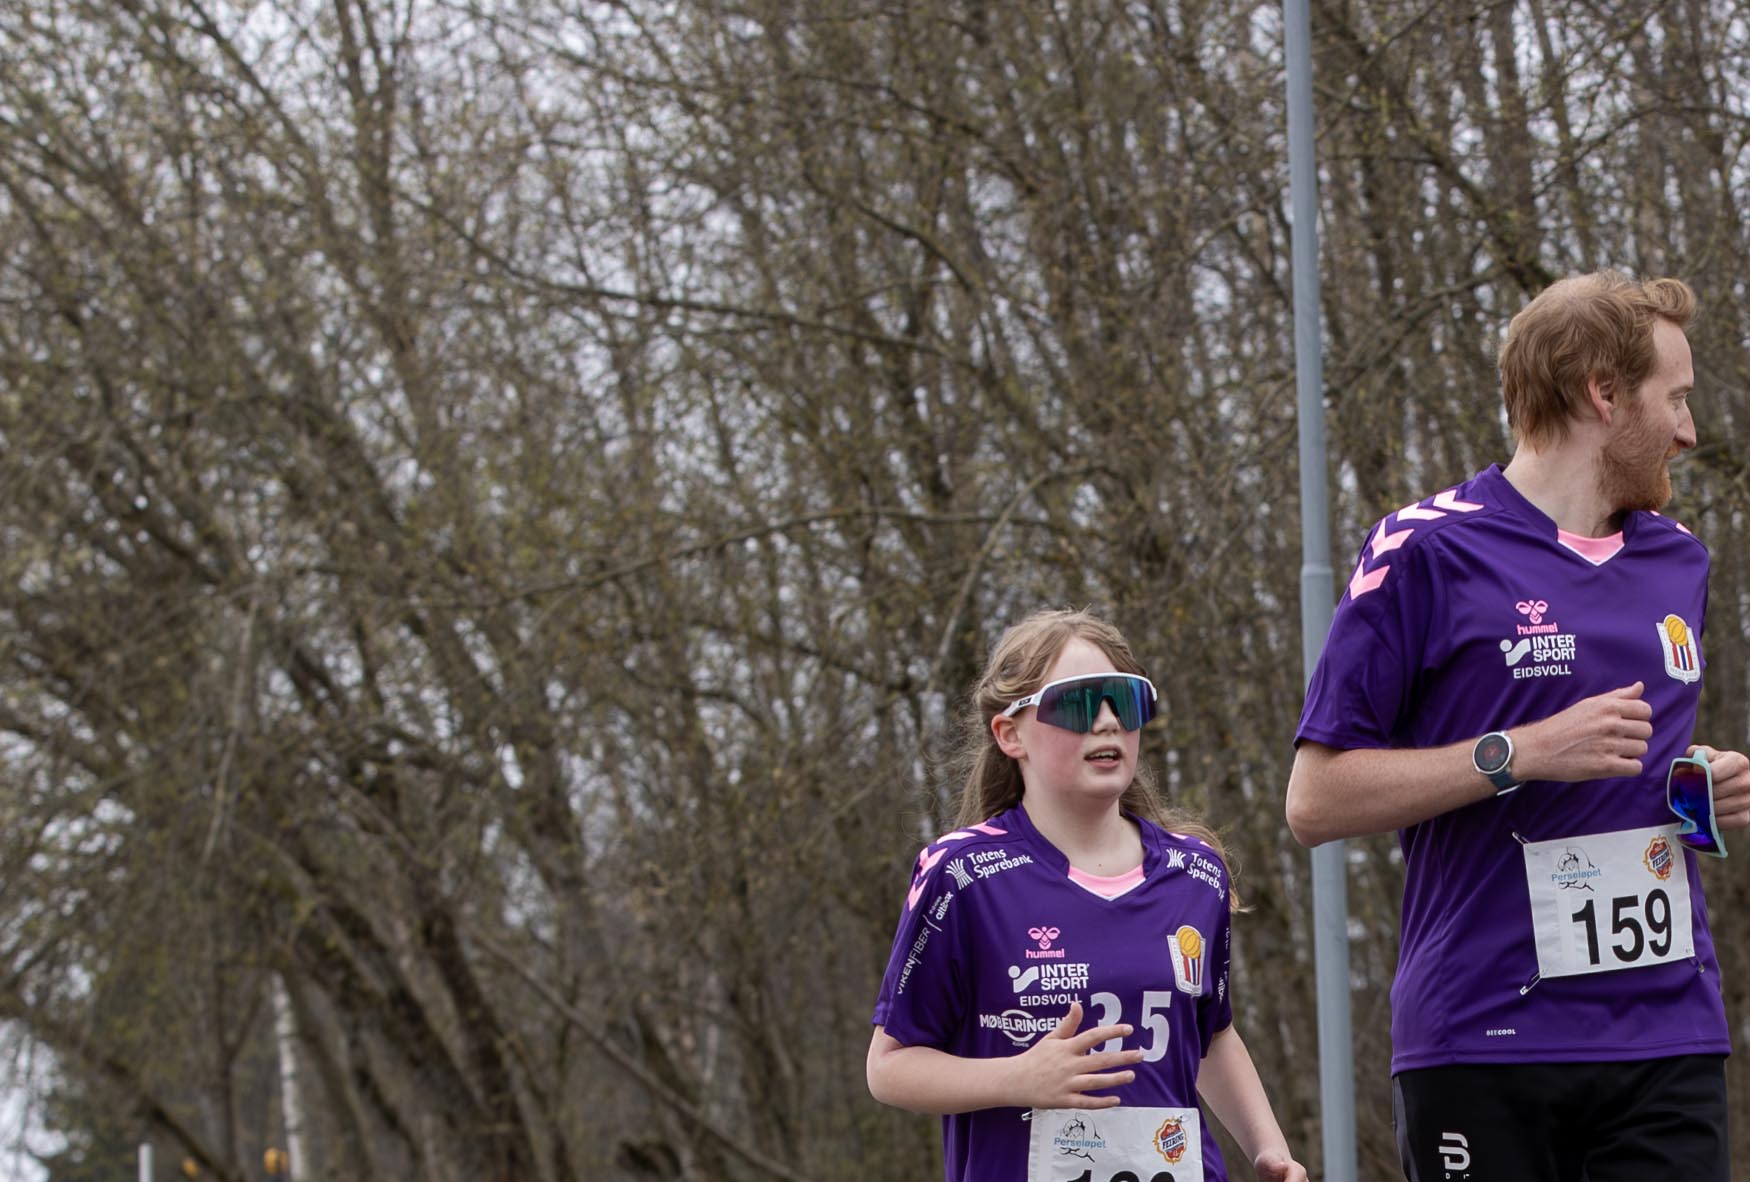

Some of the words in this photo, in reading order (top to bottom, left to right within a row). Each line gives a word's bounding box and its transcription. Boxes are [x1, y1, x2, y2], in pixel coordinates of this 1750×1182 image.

[1516, 622, 1559, 635] hummel
[1532, 634, 1576, 650] INTER
[1533, 647, 1576, 662] SPORT
[1513, 664, 1572, 679] EIDSVOLL
[967, 849, 1007, 866] Totens
[1191, 852, 1222, 878] Totens
[973, 854, 1034, 879] Sparebank
[1572, 888, 1672, 965] 159
[1025, 948, 1065, 959] hummel
[1041, 963, 1090, 978] INTER
[1040, 976, 1089, 990] SPORT
[1019, 993, 1082, 1007] EIDSVOLL
